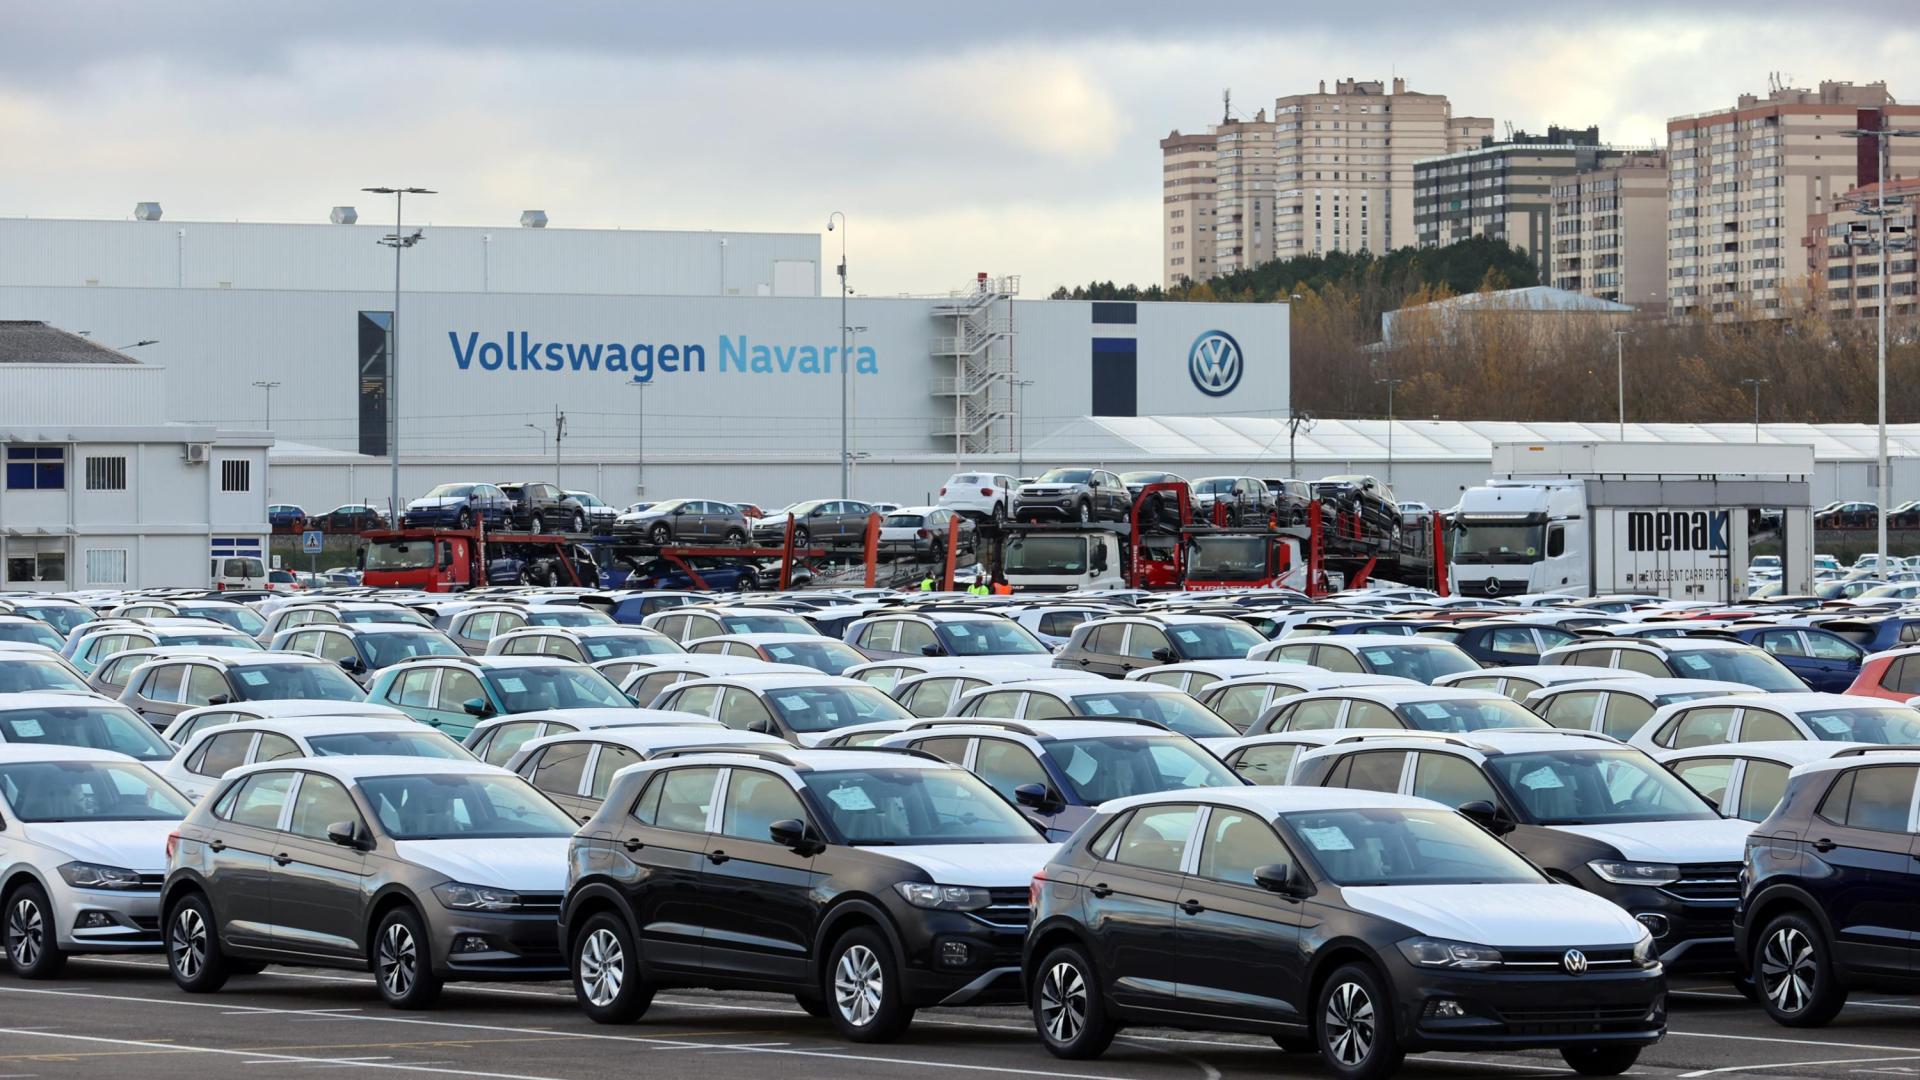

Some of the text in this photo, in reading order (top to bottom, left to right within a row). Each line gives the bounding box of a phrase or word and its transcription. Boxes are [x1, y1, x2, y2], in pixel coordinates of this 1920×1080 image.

[447, 331, 878, 383] Volkswagen Navarra
[1193, 336, 1239, 392] VW
[1645, 569, 1683, 582] EXCELLENT
[1685, 568, 1714, 581] CARRIER
[1565, 949, 1586, 973] VW
